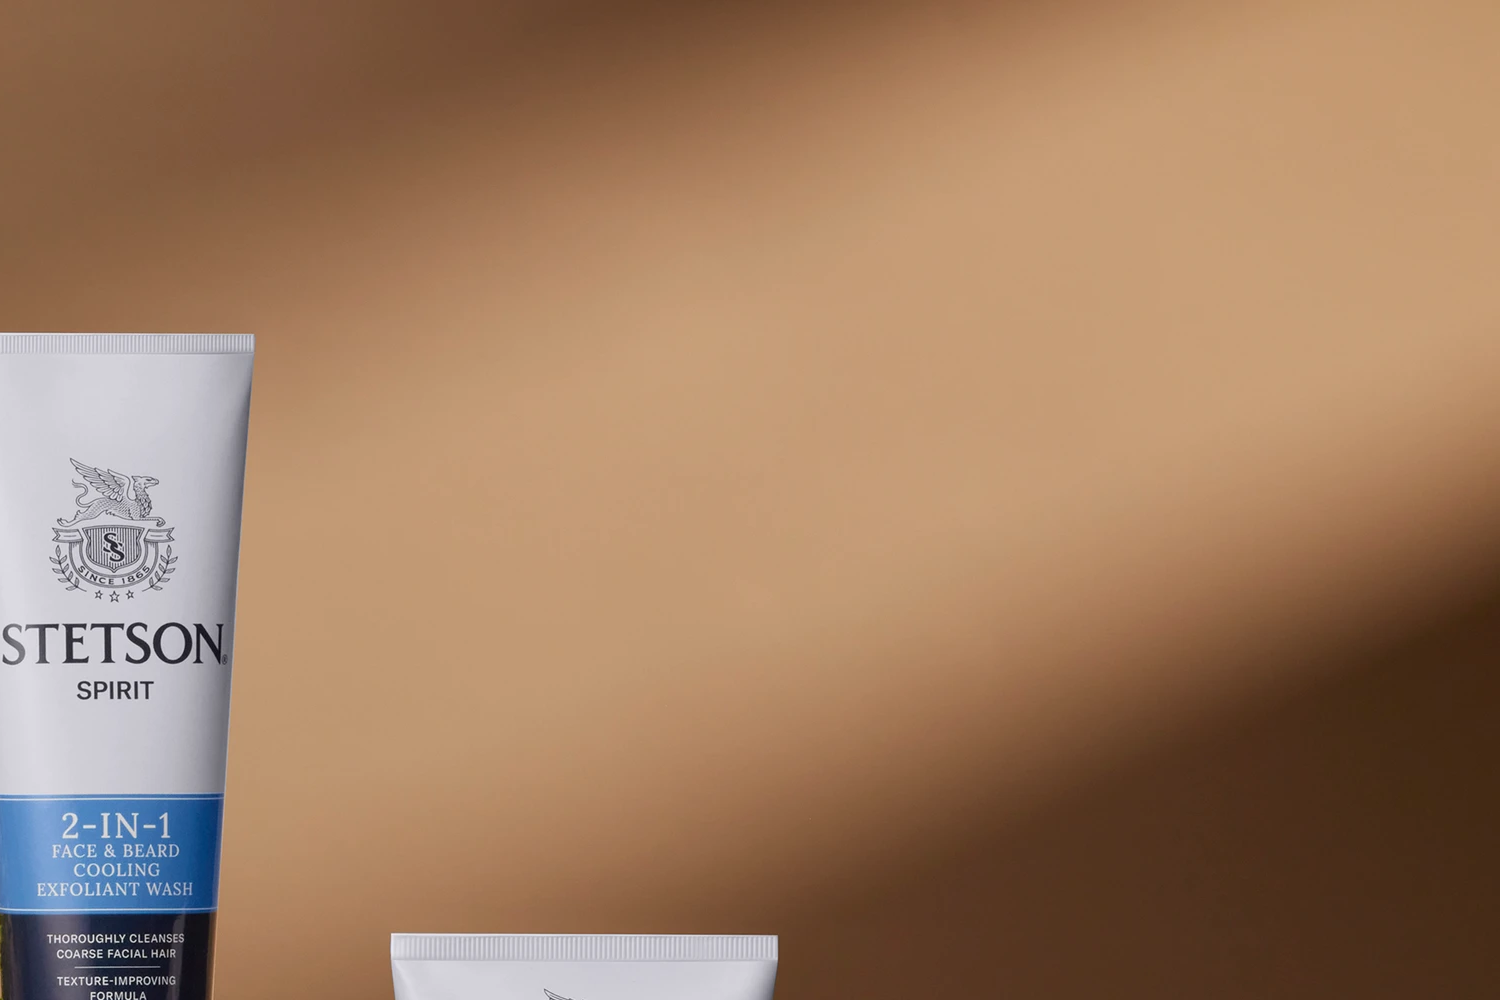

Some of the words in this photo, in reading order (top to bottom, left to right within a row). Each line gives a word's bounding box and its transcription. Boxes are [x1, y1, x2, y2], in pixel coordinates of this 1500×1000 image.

[78, 565, 115, 585] SINCE
[121, 565, 151, 585] 1865
[76, 680, 154, 700] SPIRIT
[61, 812, 171, 839] 2-IN-1
[52, 844, 97, 859] FACE
[104, 844, 116, 858] &
[123, 844, 180, 858] BEARD
[73, 863, 160, 877] COOLING
[37, 883, 139, 897] EXFOLIANT
[146, 882, 193, 896] WASH
[47, 934, 126, 944] THOROUGHLY
[129, 934, 185, 943] CLEANSES
[56, 949, 103, 959] COARSE
[108, 949, 148, 959] FACIAL
[151, 949, 176, 959] HAIR
[57, 976, 176, 986] TEXTURE-IMPROVING
[90, 991, 147, 1000] FORMULA
